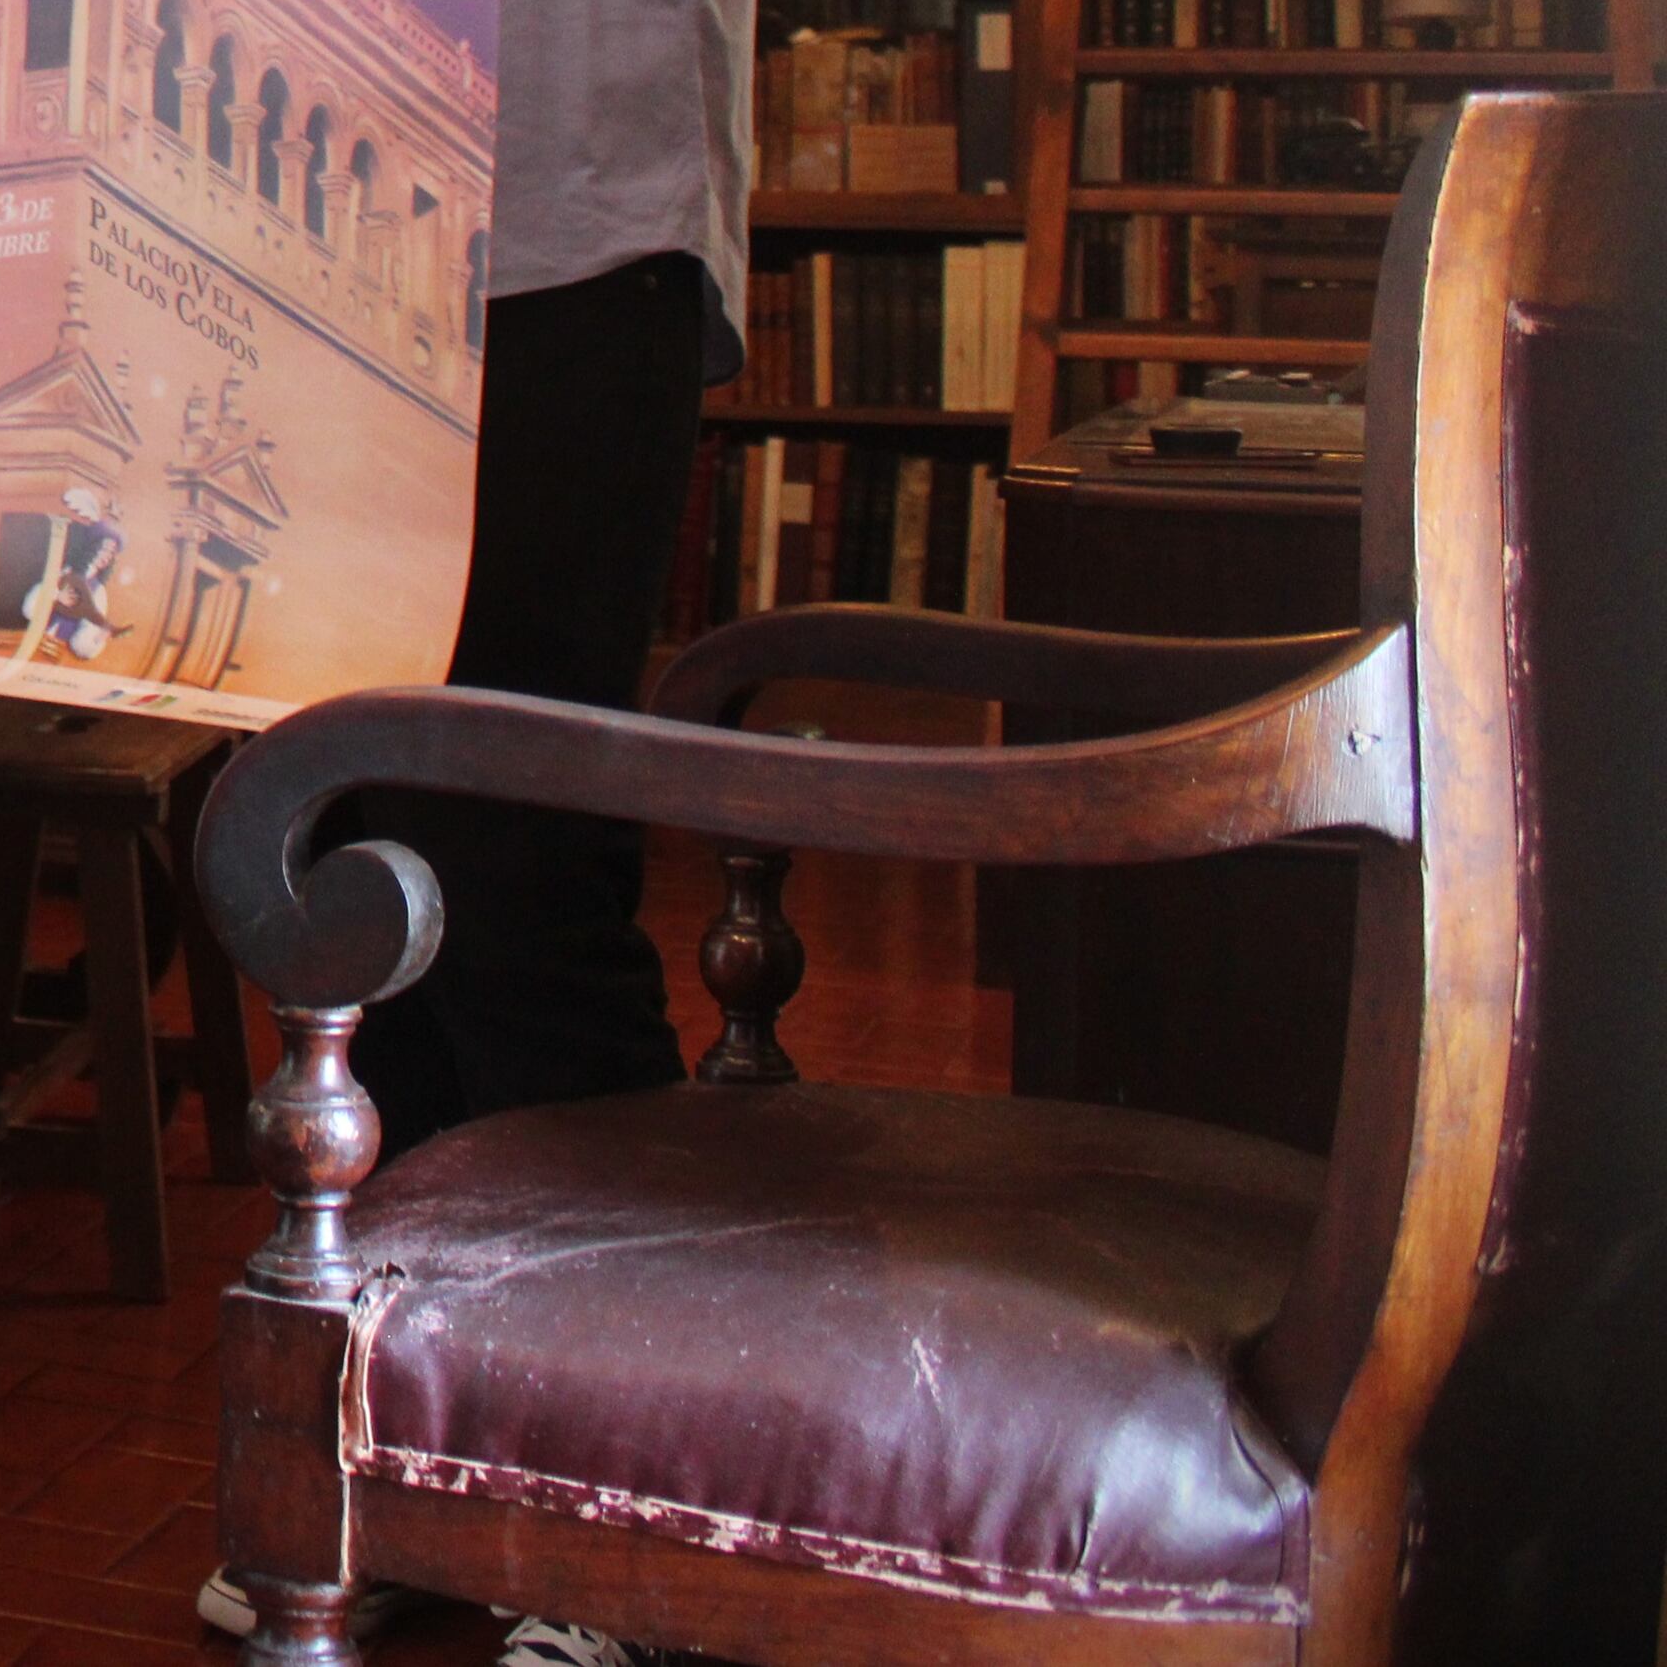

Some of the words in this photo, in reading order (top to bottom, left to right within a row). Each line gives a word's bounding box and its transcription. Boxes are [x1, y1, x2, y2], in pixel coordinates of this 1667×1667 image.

[23, 197, 55, 221] DE
[89, 239, 117, 277] DE
[126, 265, 167, 310] LOS
[177, 291, 259, 371] COBOS
